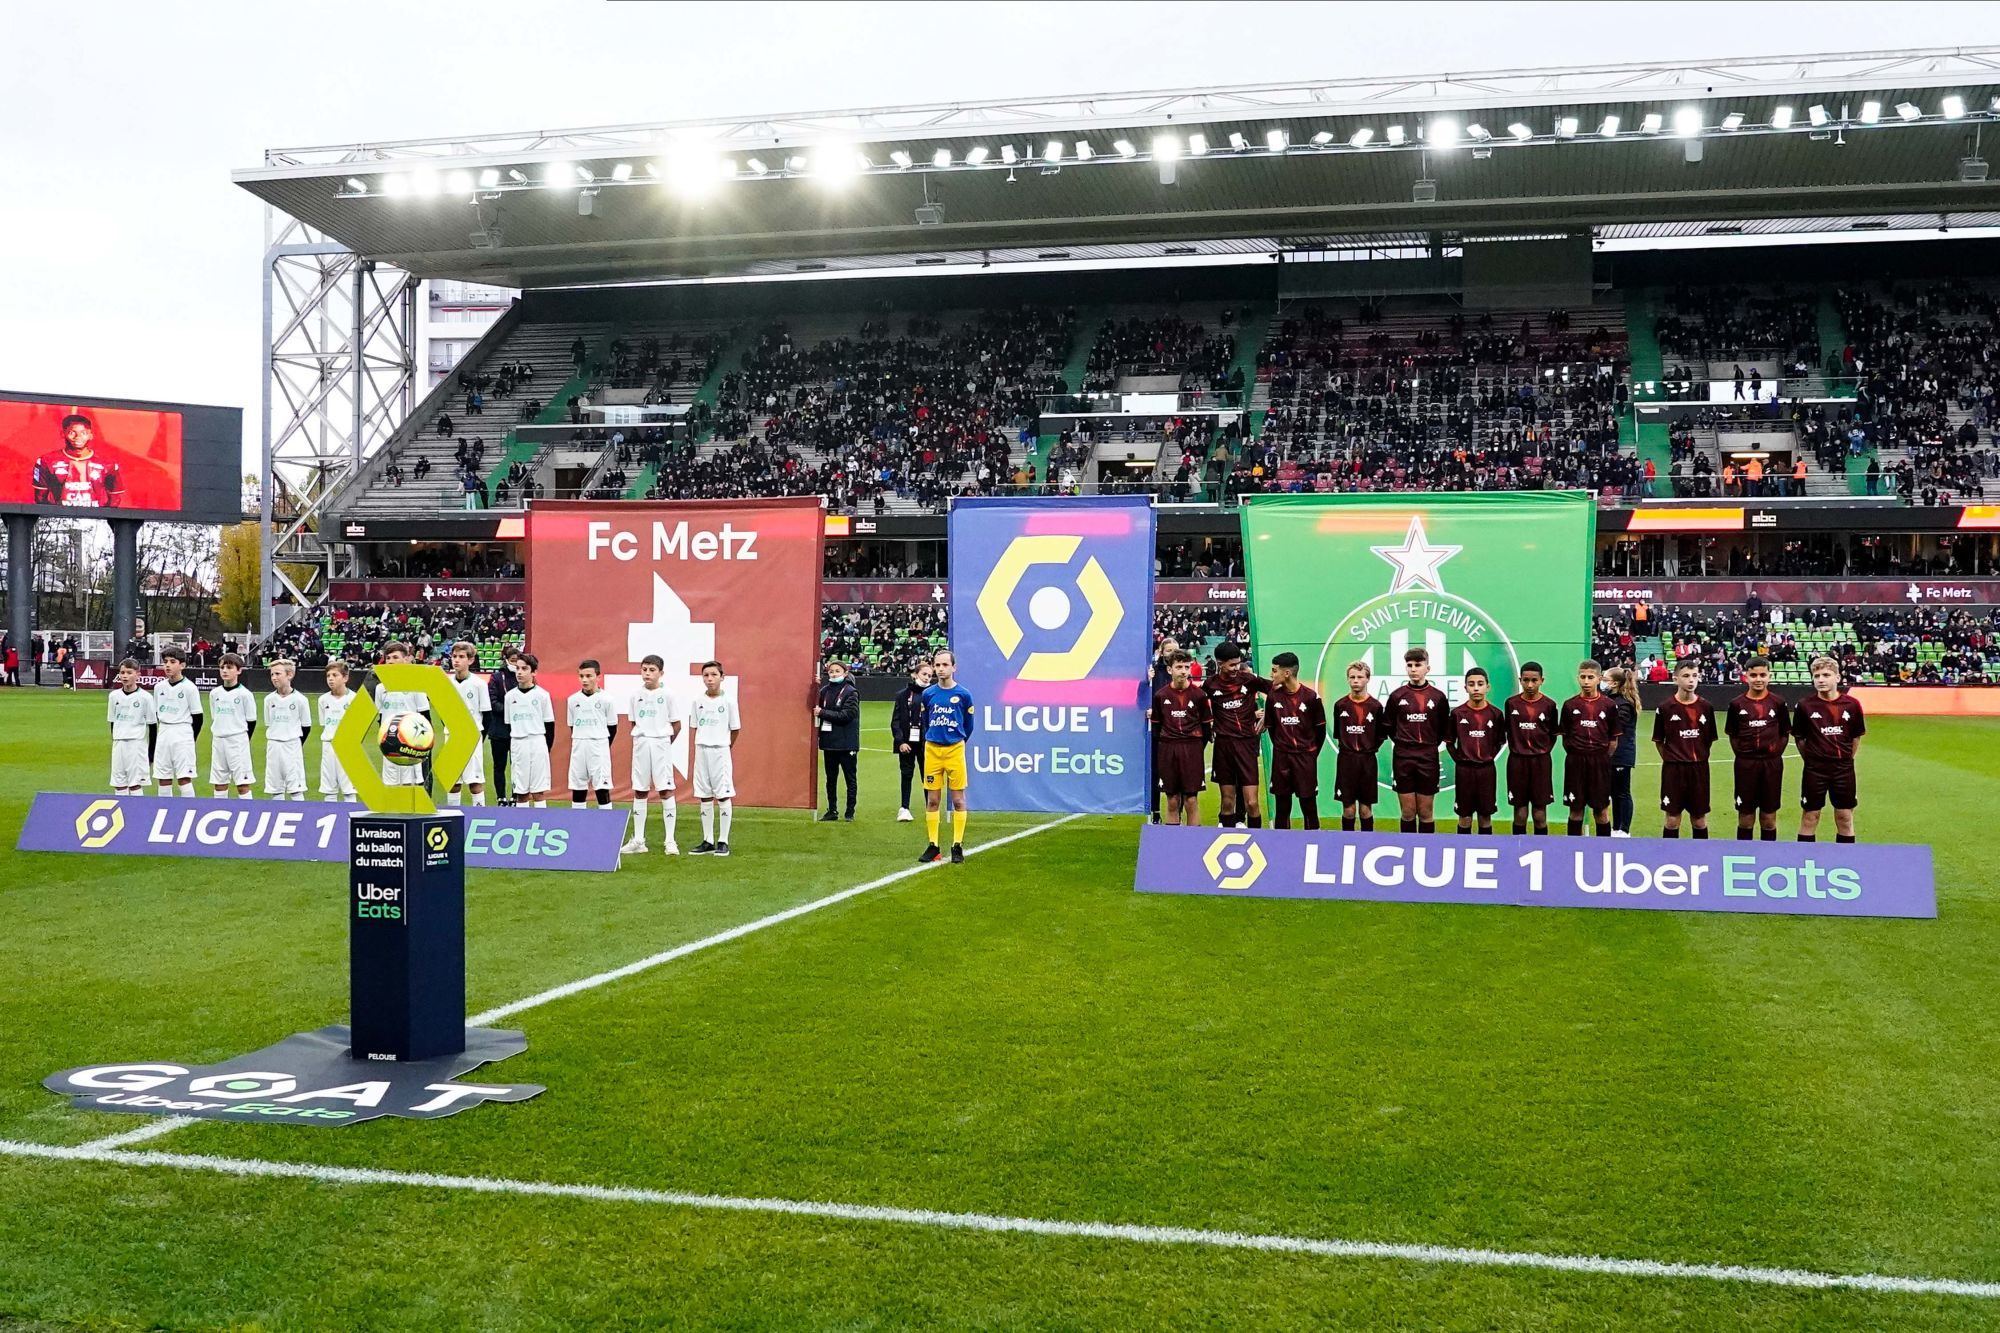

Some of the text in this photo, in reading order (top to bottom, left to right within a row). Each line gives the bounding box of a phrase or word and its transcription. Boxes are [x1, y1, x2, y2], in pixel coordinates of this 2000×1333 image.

[588, 521, 758, 561] Fc Metz
[437, 588, 470, 597] Fc Metz
[1926, 587, 1971, 597] Fc Metz
[1350, 600, 1486, 642] SAINT-ETIENNE
[984, 705, 1114, 733] LIGUE 1
[399, 746, 430, 757] uhlsport
[973, 746, 1125, 775] Uber Eats
[147, 808, 570, 857] LIGUE 1 Eats
[356, 828, 401, 839] Livraison
[356, 842, 403, 853] du ballon
[356, 856, 403, 867] du match
[1303, 843, 1862, 900] LIGUE 1 Uber Eats
[357, 883, 401, 901] Uber
[358, 901, 401, 919] Eats
[368, 1053, 396, 1061] PELOUSE
[96, 1093, 356, 1119] Uber Eats
